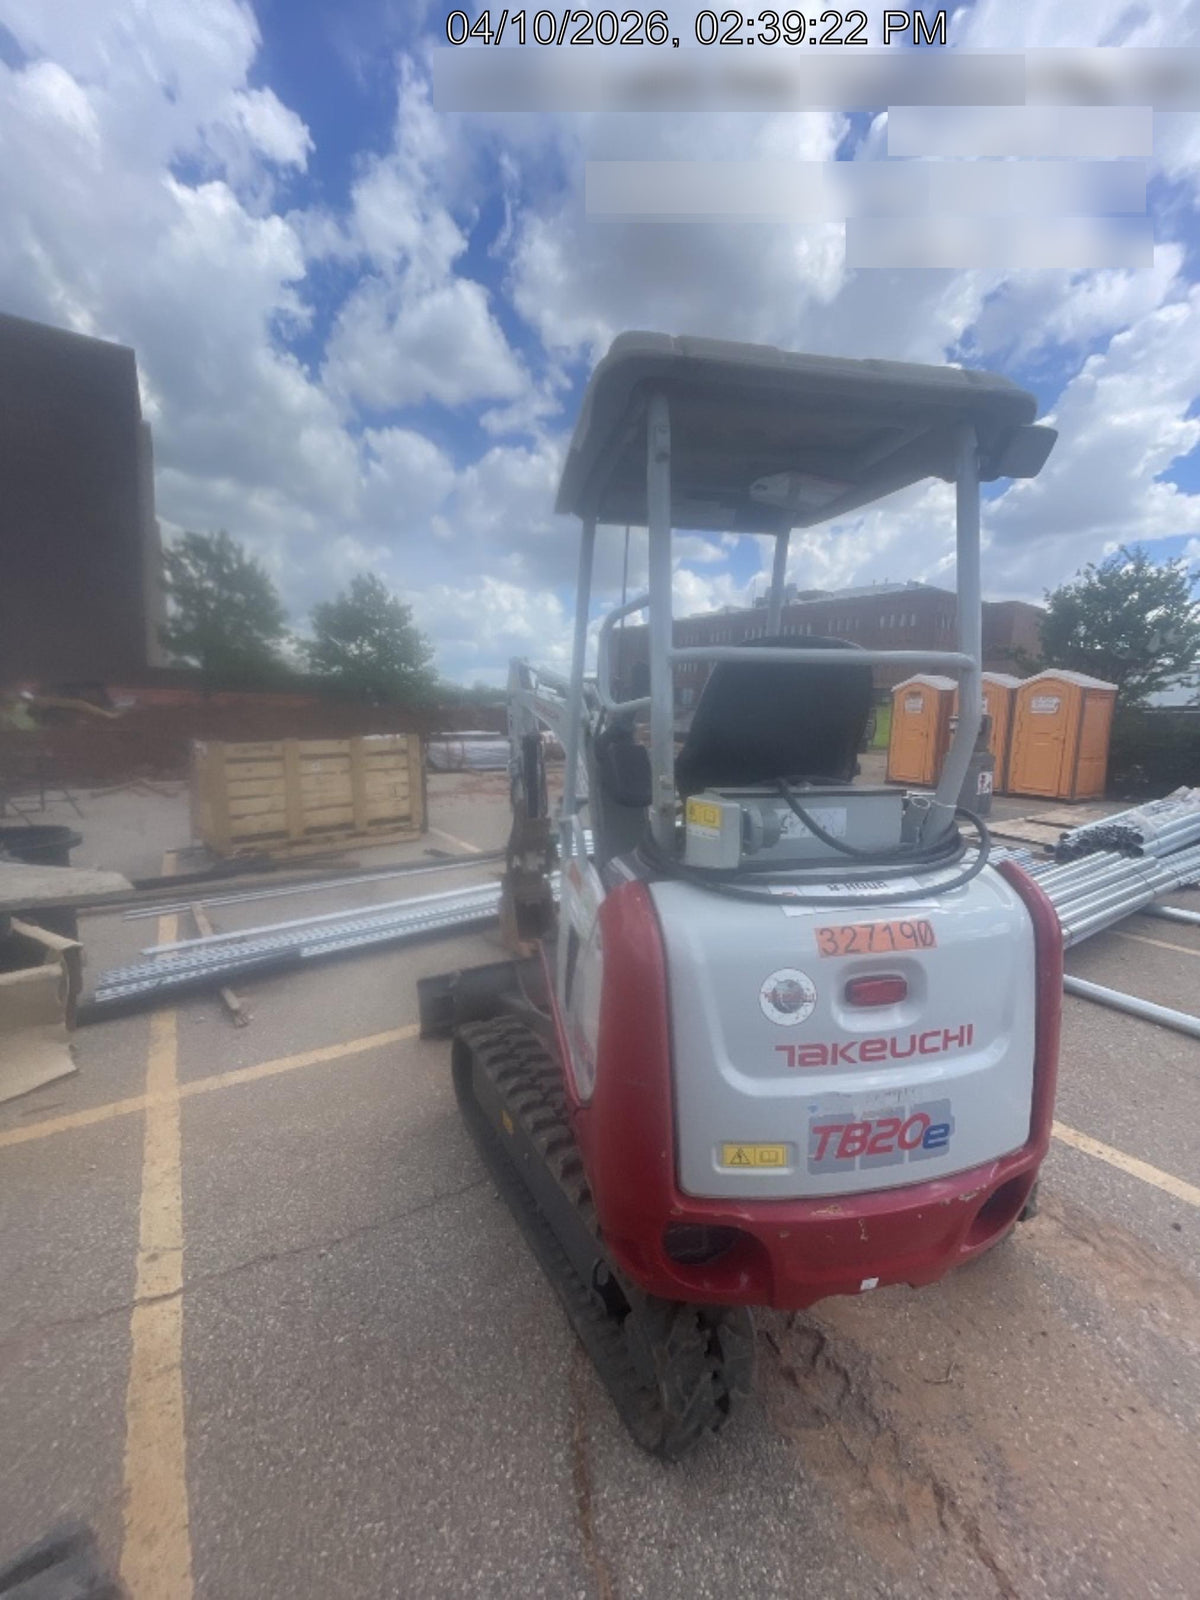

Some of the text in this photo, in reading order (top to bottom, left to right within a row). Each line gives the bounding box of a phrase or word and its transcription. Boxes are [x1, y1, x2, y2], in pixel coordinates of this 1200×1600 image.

[819, 919, 935, 956] 327190
[775, 1023, 974, 1068] TAKEUCHI
[812, 1112, 950, 1162] TB20e
